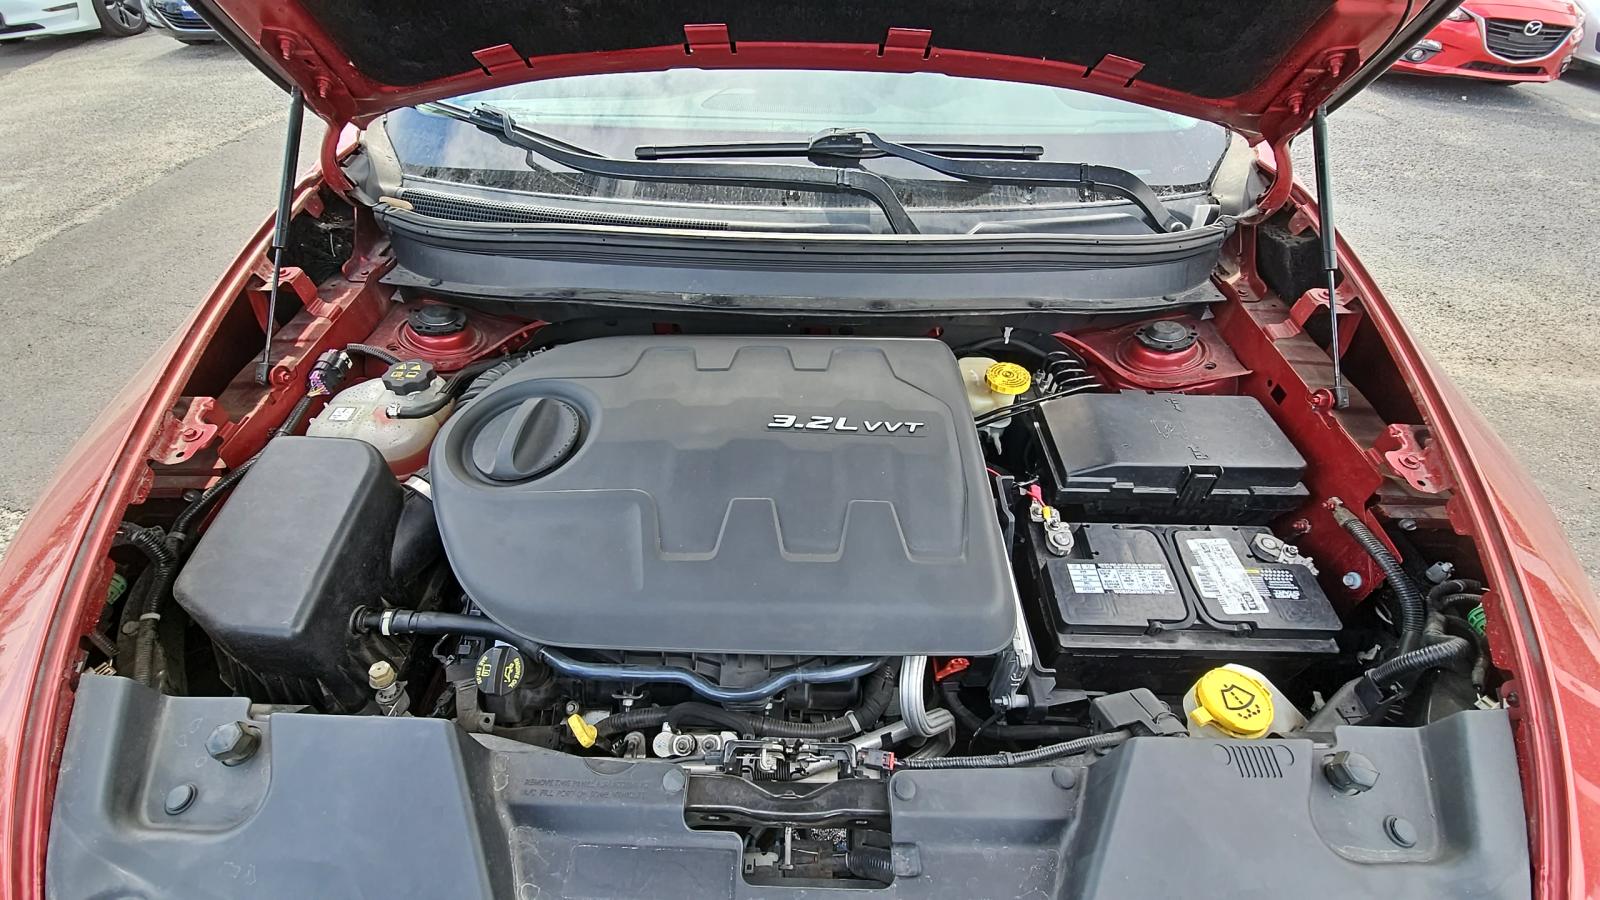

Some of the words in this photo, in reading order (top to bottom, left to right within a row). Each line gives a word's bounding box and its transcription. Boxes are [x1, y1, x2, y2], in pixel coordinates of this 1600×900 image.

[767, 414, 858, 431] 3.2L
[863, 420, 925, 433] VVT
[508, 679, 517, 688] OIL
